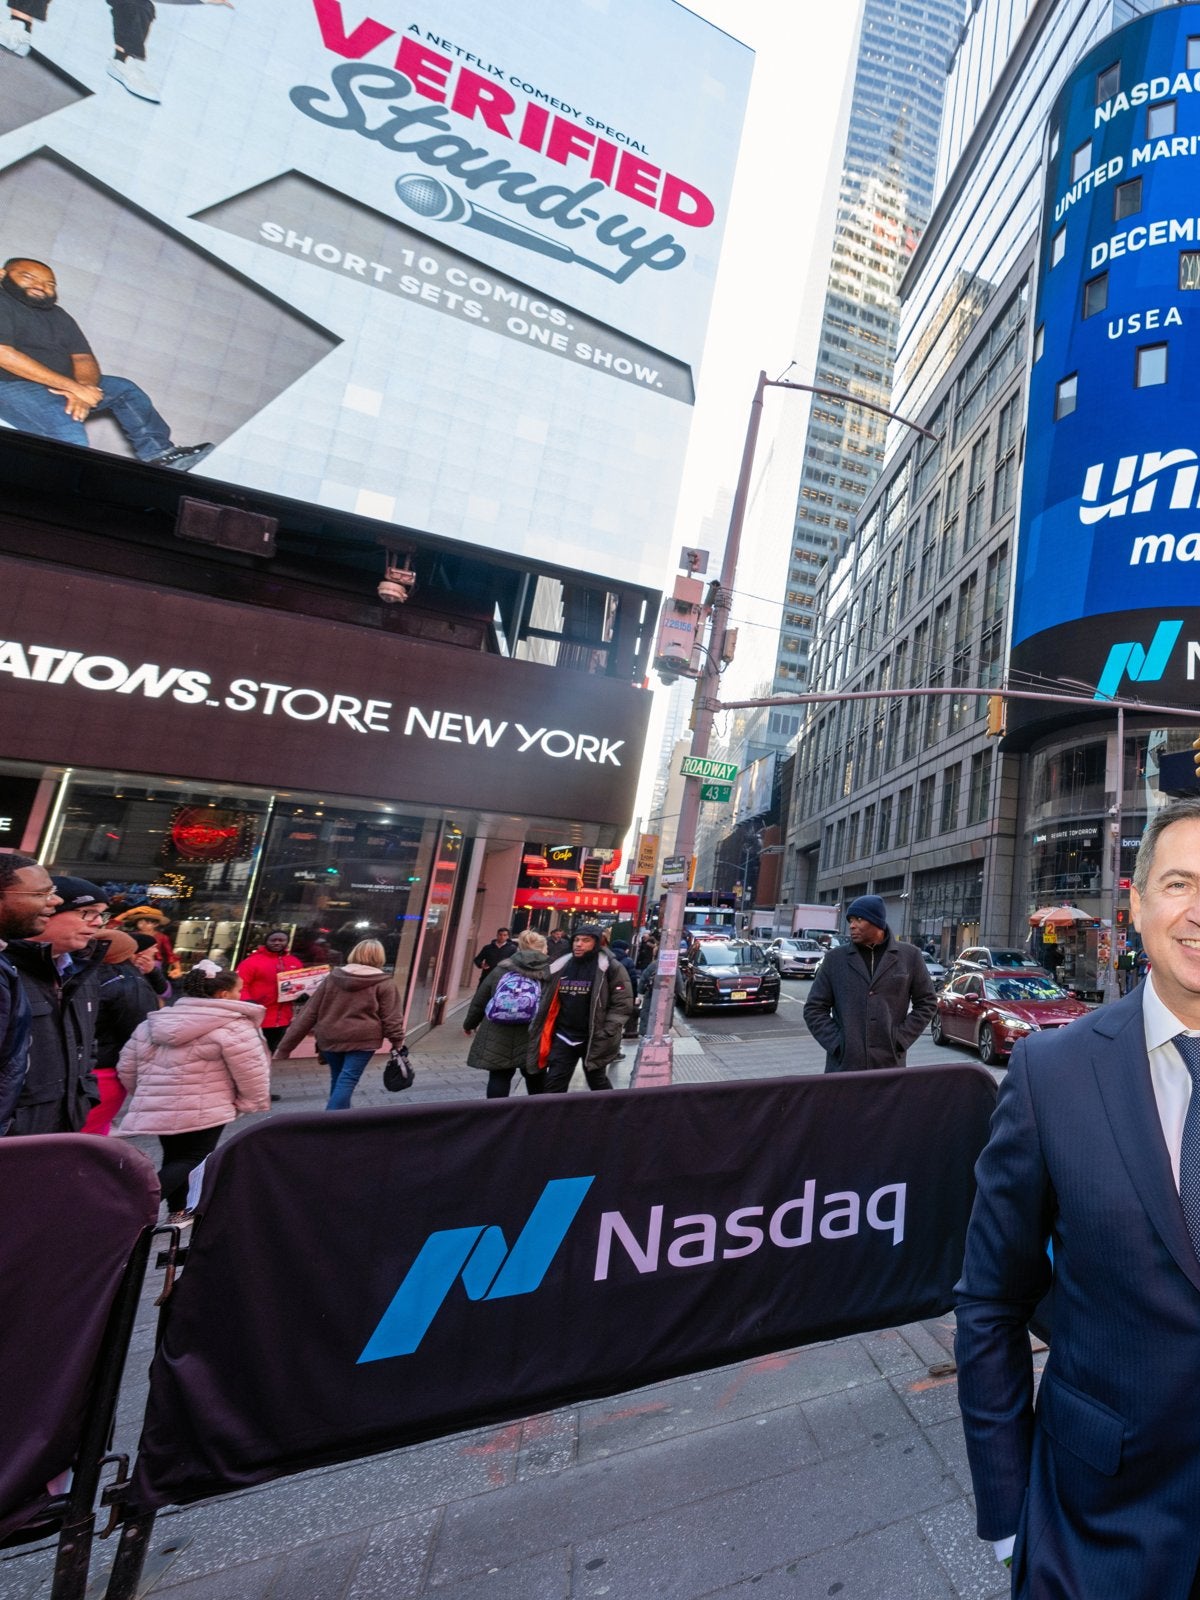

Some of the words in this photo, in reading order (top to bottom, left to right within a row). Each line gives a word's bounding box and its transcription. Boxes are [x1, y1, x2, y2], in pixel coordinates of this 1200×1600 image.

[312, 0, 715, 228] VERIFIED
[408, 24, 421, 36] A
[427, 31, 504, 80] NETFLIX
[510, 76, 582, 118] COMEDY
[586, 116, 649, 155] SPECIAL
[289, 62, 687, 284] Stand-up
[1055, 156, 1123, 221] UNITED
[259, 222, 392, 282] SHORT
[399, 275, 490, 322] SETS.
[507, 317, 569, 351] ONE
[574, 342, 663, 387] SHOW.
[401, 249, 439, 275] 10
[446, 267, 574, 331] COMICS.
[1108, 306, 1183, 340] USEA
[0, 640, 211, 704] ATIONS
[225, 679, 392, 733] STORE
[404, 707, 508, 747] NEW
[515, 723, 625, 766] YORK
[682, 758, 735, 779] ROADWAY
[706, 787, 719, 800] 43
[1123, 839, 1142, 847] bran
[594, 1179, 906, 1281] Nasdaq
